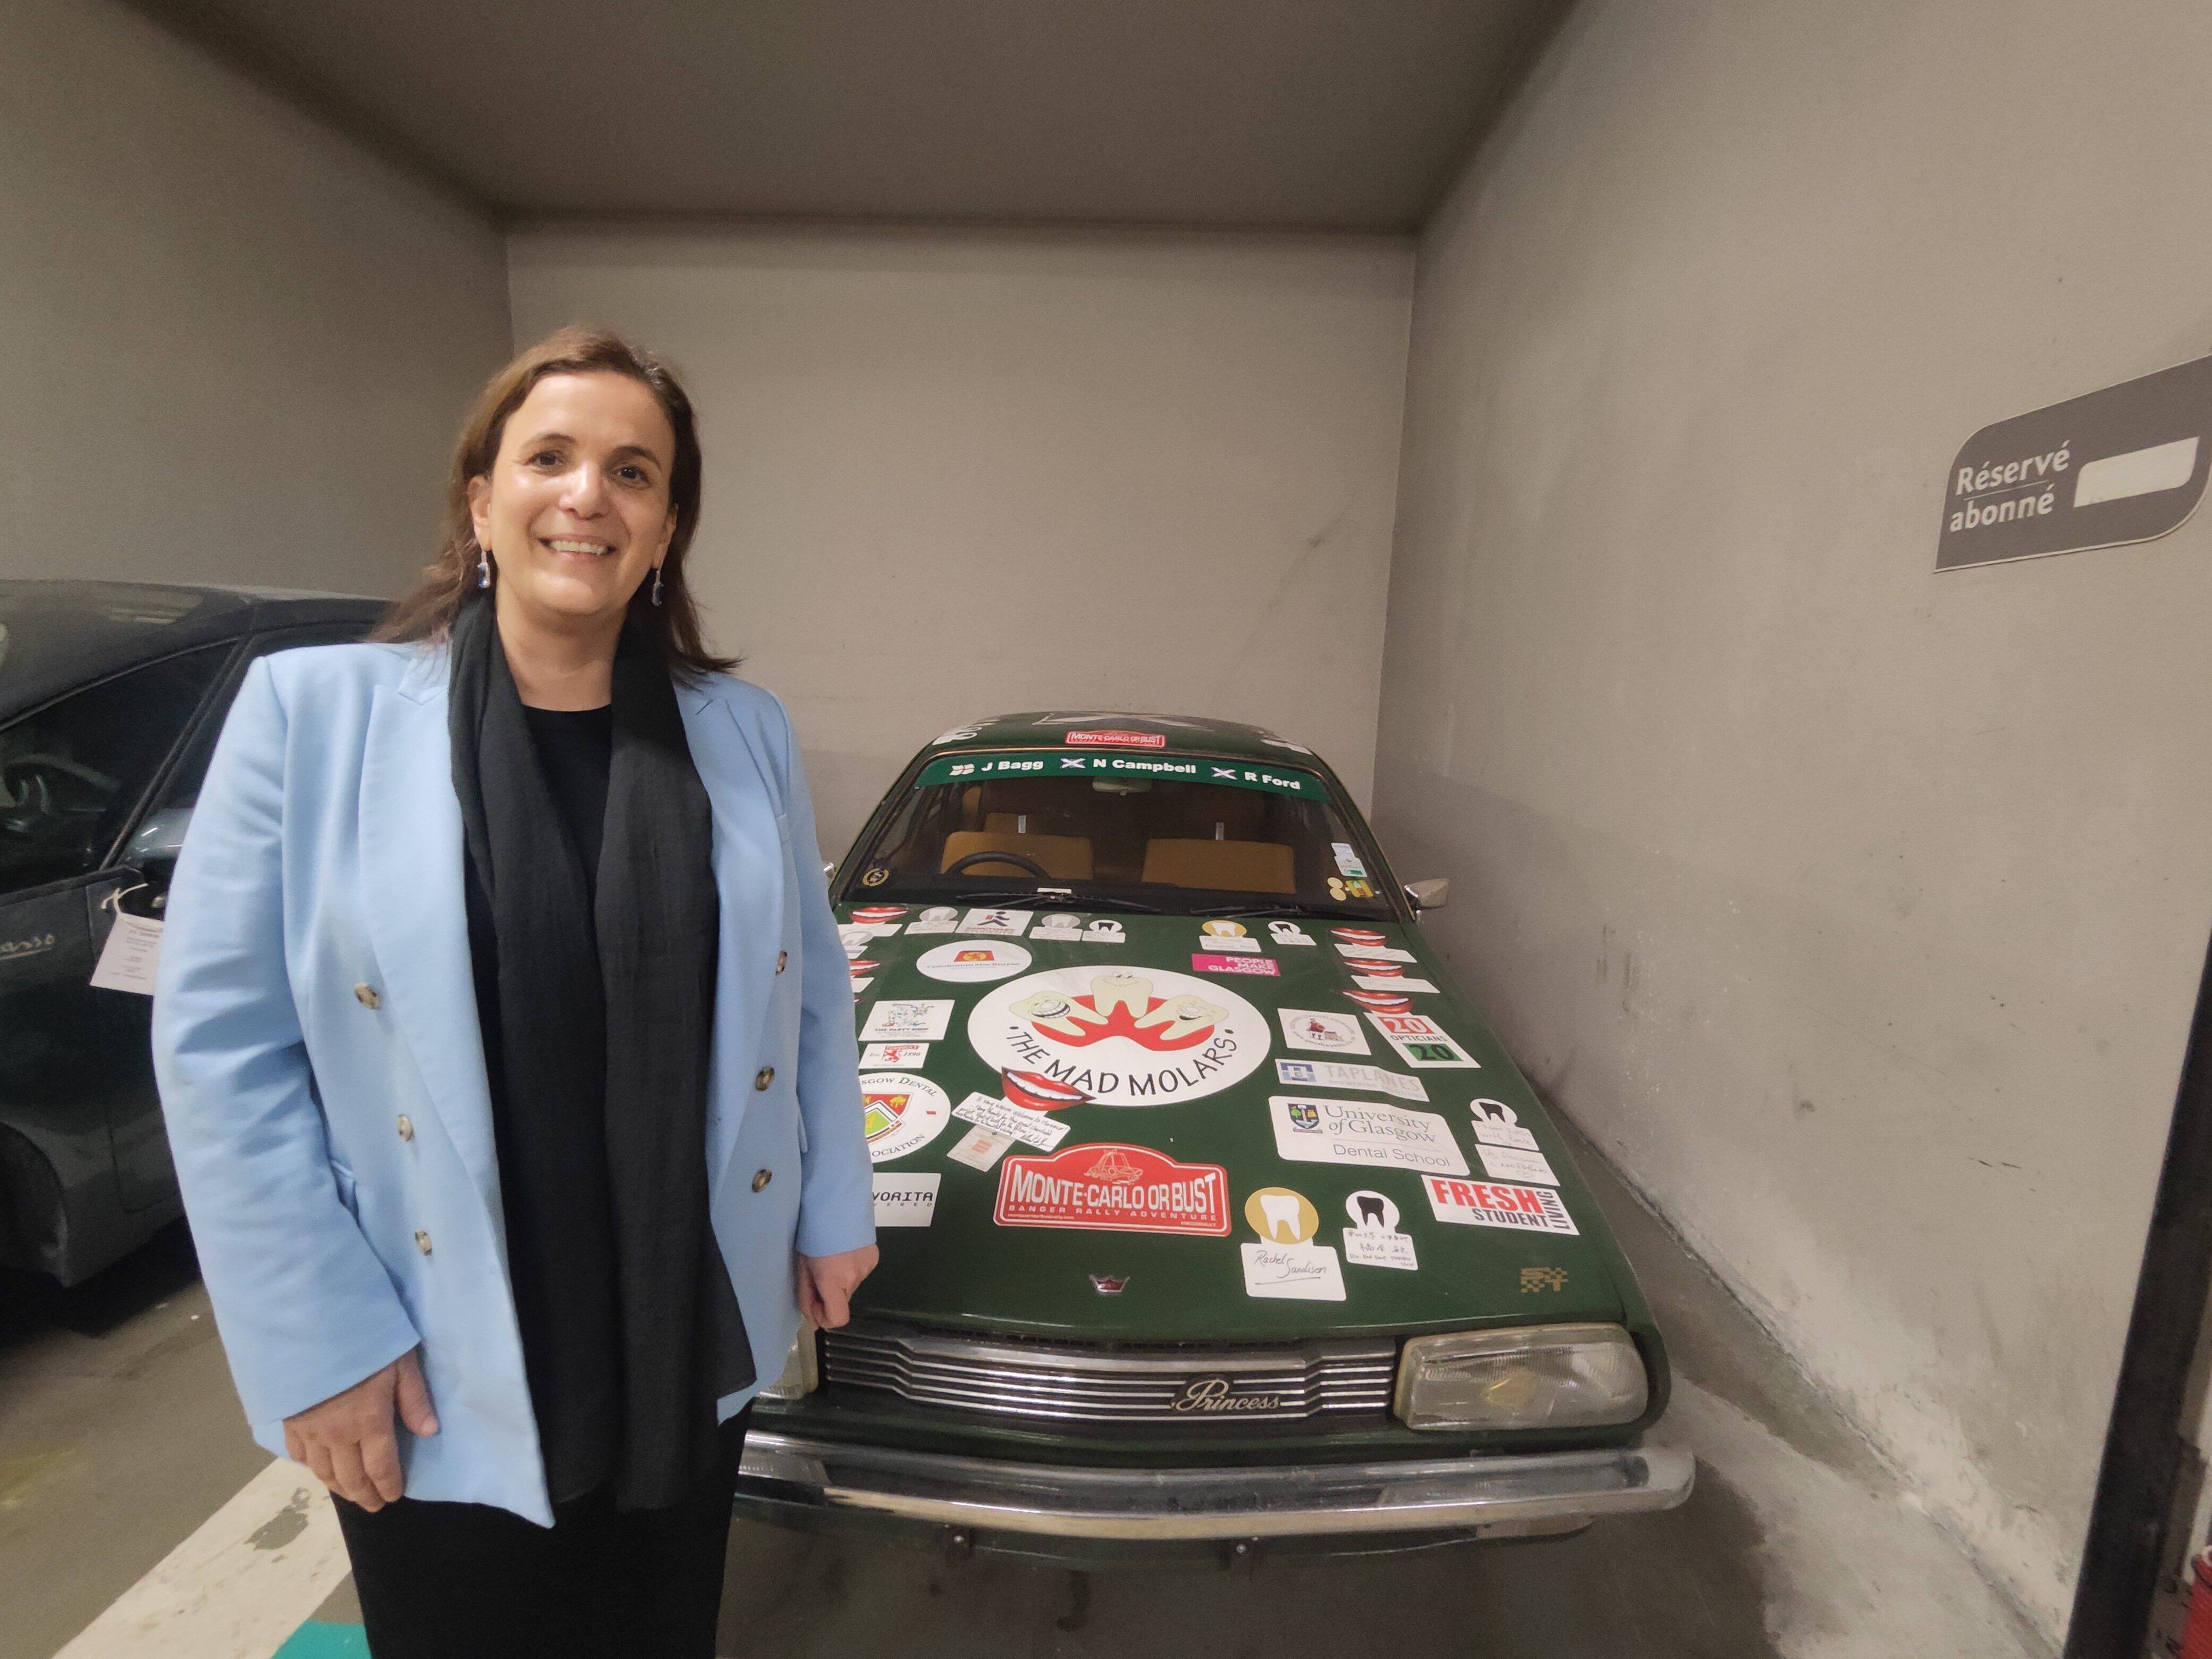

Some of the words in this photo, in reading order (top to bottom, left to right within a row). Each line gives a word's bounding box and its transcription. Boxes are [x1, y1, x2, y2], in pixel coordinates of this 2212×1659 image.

[1956, 440, 2070, 496] Réservé
[1949, 484, 2056, 532] abonné
[981, 762, 993, 771] J
[998, 760, 1044, 770] Bagg
[1093, 758, 1107, 768] N
[1111, 759, 1196, 774] Campbell
[1244, 772, 1258, 782] R
[1262, 774, 1301, 790] Ford
[1208, 965, 1276, 975] GLASGOW
[1383, 1017, 1428, 1033] 20
[1006, 1031, 1051, 1065] THE
[1043, 1059, 1119, 1094] MAD
[1128, 1037, 1238, 1096] MOLARS
[1409, 1044, 1454, 1060] 20
[1323, 1065, 1420, 1091] TAPLANES
[1323, 1105, 1430, 1133] University
[1329, 1118, 1347, 1135] of
[1348, 1120, 1436, 1143] Glasgow
[1333, 1144, 1387, 1159] Dental
[1393, 1149, 1450, 1167] School
[1147, 1184, 1170, 1211] OR
[1171, 1172, 1217, 1214] BUST
[1430, 1179, 1545, 1214] FRESH
[1009, 1204, 1066, 1213] BANGER
[1129, 1210, 1217, 1221] ADVENTURE
[1472, 1208, 1549, 1228] STUDENT
[1536, 1191, 1572, 1231] LIVING
[1254, 1250, 1287, 1267] Rachel
[1276, 1258, 1326, 1278] Sandison
[1171, 1378, 1279, 1411] Princess
